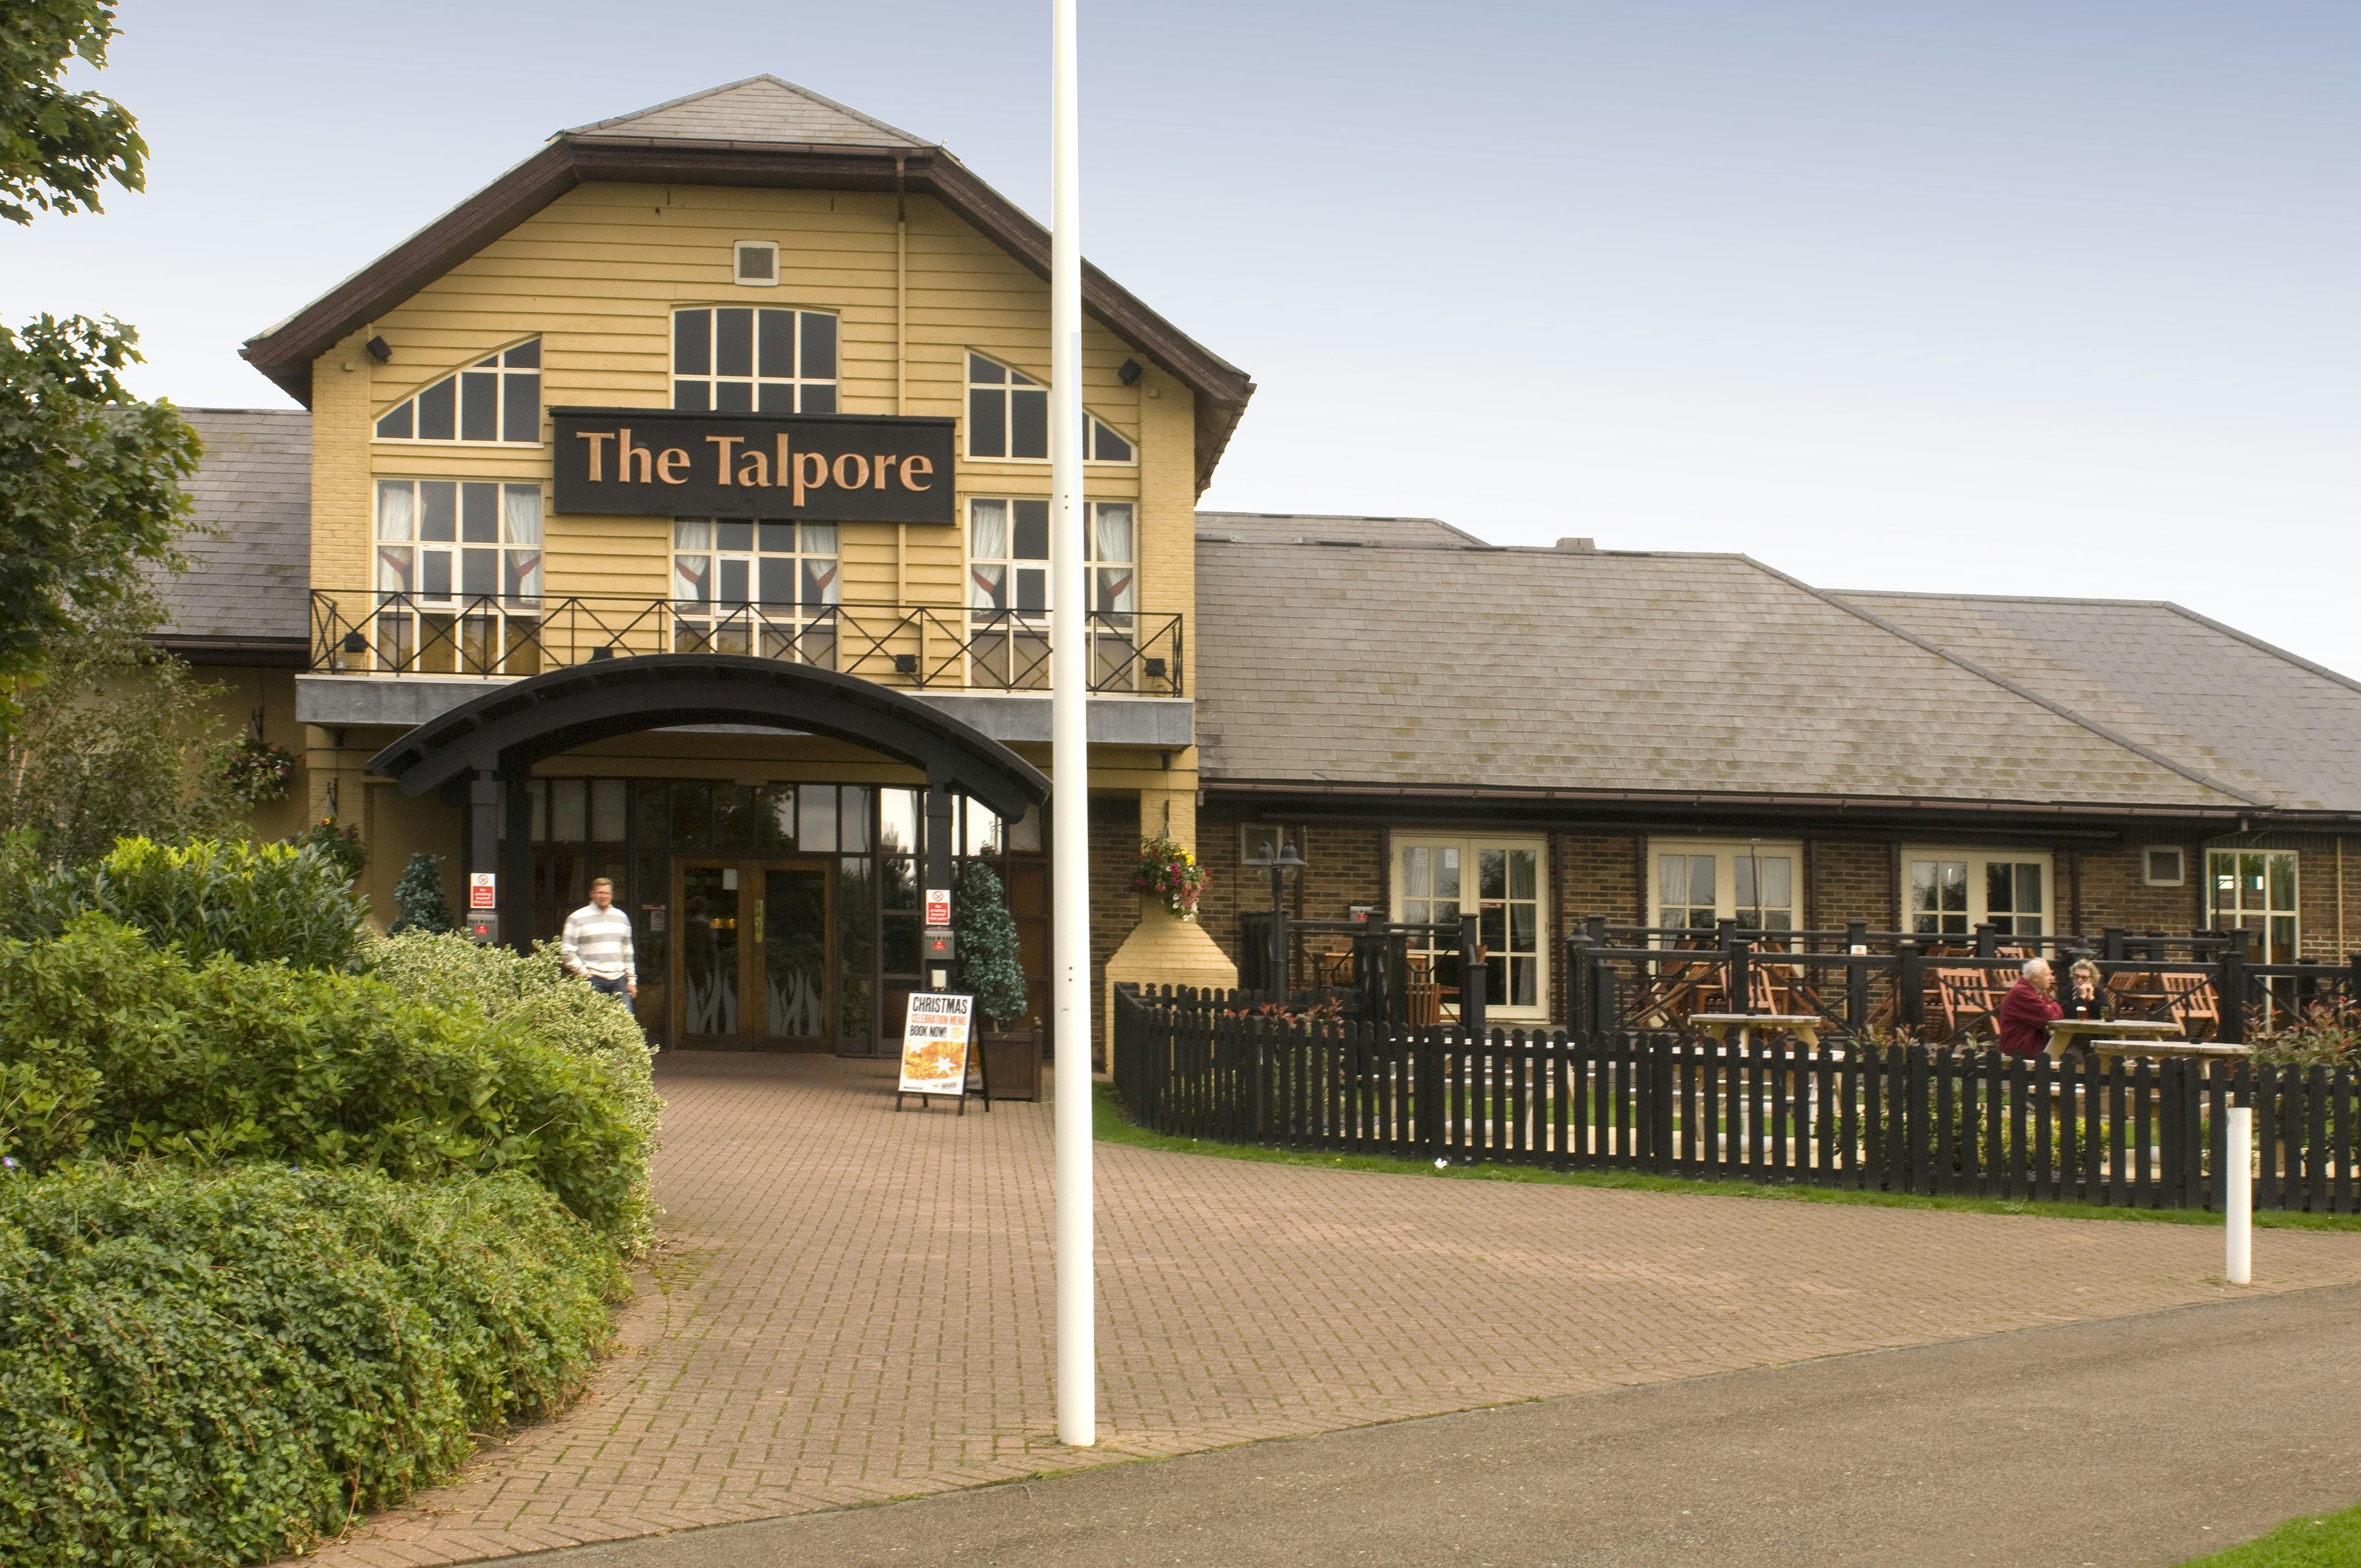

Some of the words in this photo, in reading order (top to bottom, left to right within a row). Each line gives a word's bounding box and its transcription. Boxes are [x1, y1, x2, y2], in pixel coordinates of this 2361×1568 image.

[576, 429, 690, 485] The
[705, 433, 933, 507] Talpore
[913, 996, 967, 1014] CHRISTMAS
[910, 1025, 928, 1036] BOOK
[929, 1026, 947, 1037] NOW!
